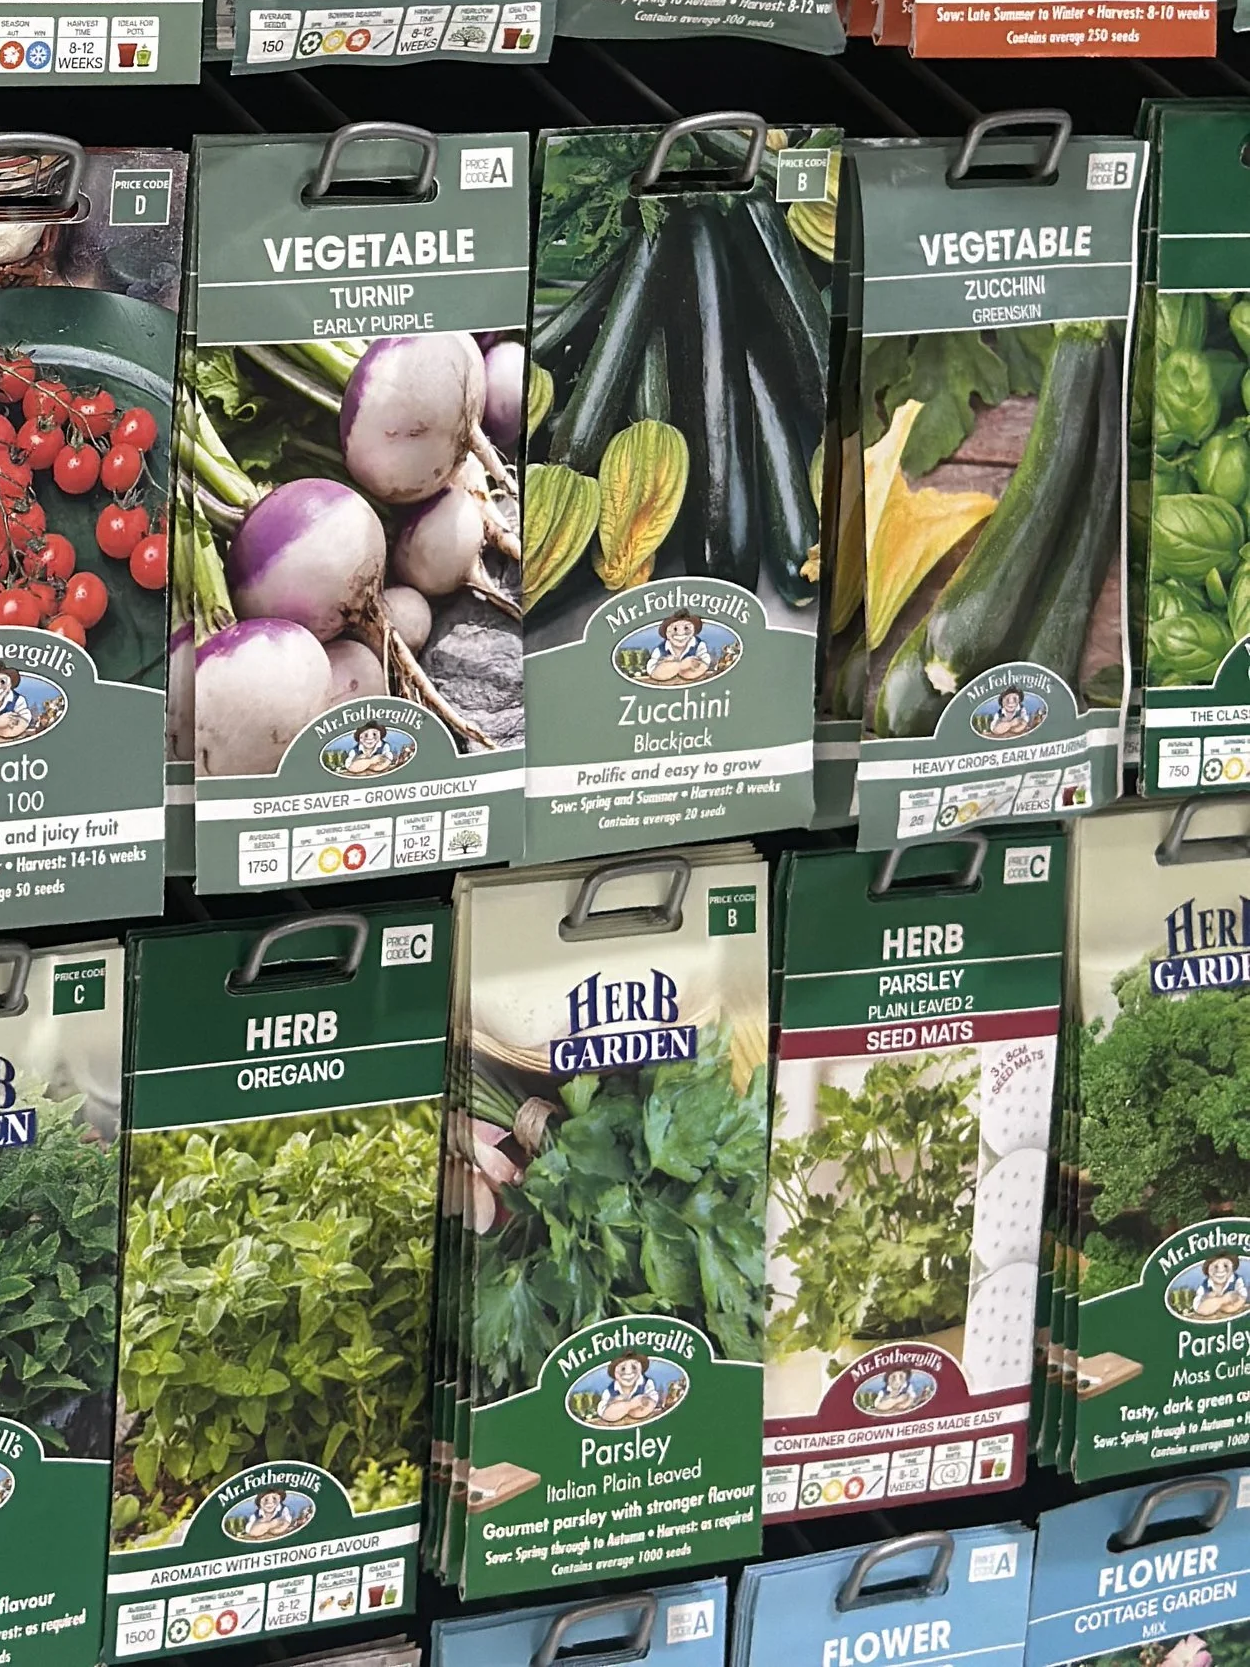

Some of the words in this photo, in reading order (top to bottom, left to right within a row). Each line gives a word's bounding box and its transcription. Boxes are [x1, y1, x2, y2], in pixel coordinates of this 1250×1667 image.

[263, 228, 475, 273] VEGETABLE
[919, 226, 1093, 266] VEGETABLE
[330, 284, 414, 310] TURNIP
[964, 275, 1045, 301] ZUCCHINI
[313, 317, 366, 336] EARLY
[370, 313, 434, 332] PURPLE
[972, 304, 1041, 325] GREENSKIN
[618, 689, 731, 726] Zucchini
[634, 728, 713, 754] Blackjack
[7, 791, 44, 814] 100
[253, 800, 300, 814] SPACE
[304, 795, 350, 810] SAVER
[365, 787, 417, 803] GROWS
[420, 780, 478, 798] QUICKLY
[883, 924, 964, 960] HERB
[880, 969, 965, 996] PARSLEY
[566, 968, 679, 1035] HERB
[868, 1002, 908, 1020] PLAIN
[911, 998, 962, 1016] LEAVED
[965, 996, 974, 1010] 2
[247, 1010, 338, 1051] HERB
[866, 1028, 916, 1051] SEED
[920, 1021, 974, 1046] MATS
[554, 1028, 696, 1071] GARDEN
[237, 1058, 345, 1091] OREGANO
[1172, 1366, 1210, 1388] Moss
[582, 1427, 672, 1468] Parsley
[546, 1484, 596, 1504] Italian
[603, 1474, 641, 1494] Plain
[648, 1458, 702, 1487] Leaved
[151, 1562, 222, 1585] AROMATIC
[226, 1557, 262, 1572] WITH
[264, 1547, 317, 1567] STRONG
[320, 1536, 380, 1556] FLAVOUR
[1098, 1544, 1219, 1597] FLOWER
[1075, 1599, 1159, 1634] COTTAGE
[1162, 1579, 1237, 1613] GARDEN
[822, 1620, 950, 1667] FLOWER
